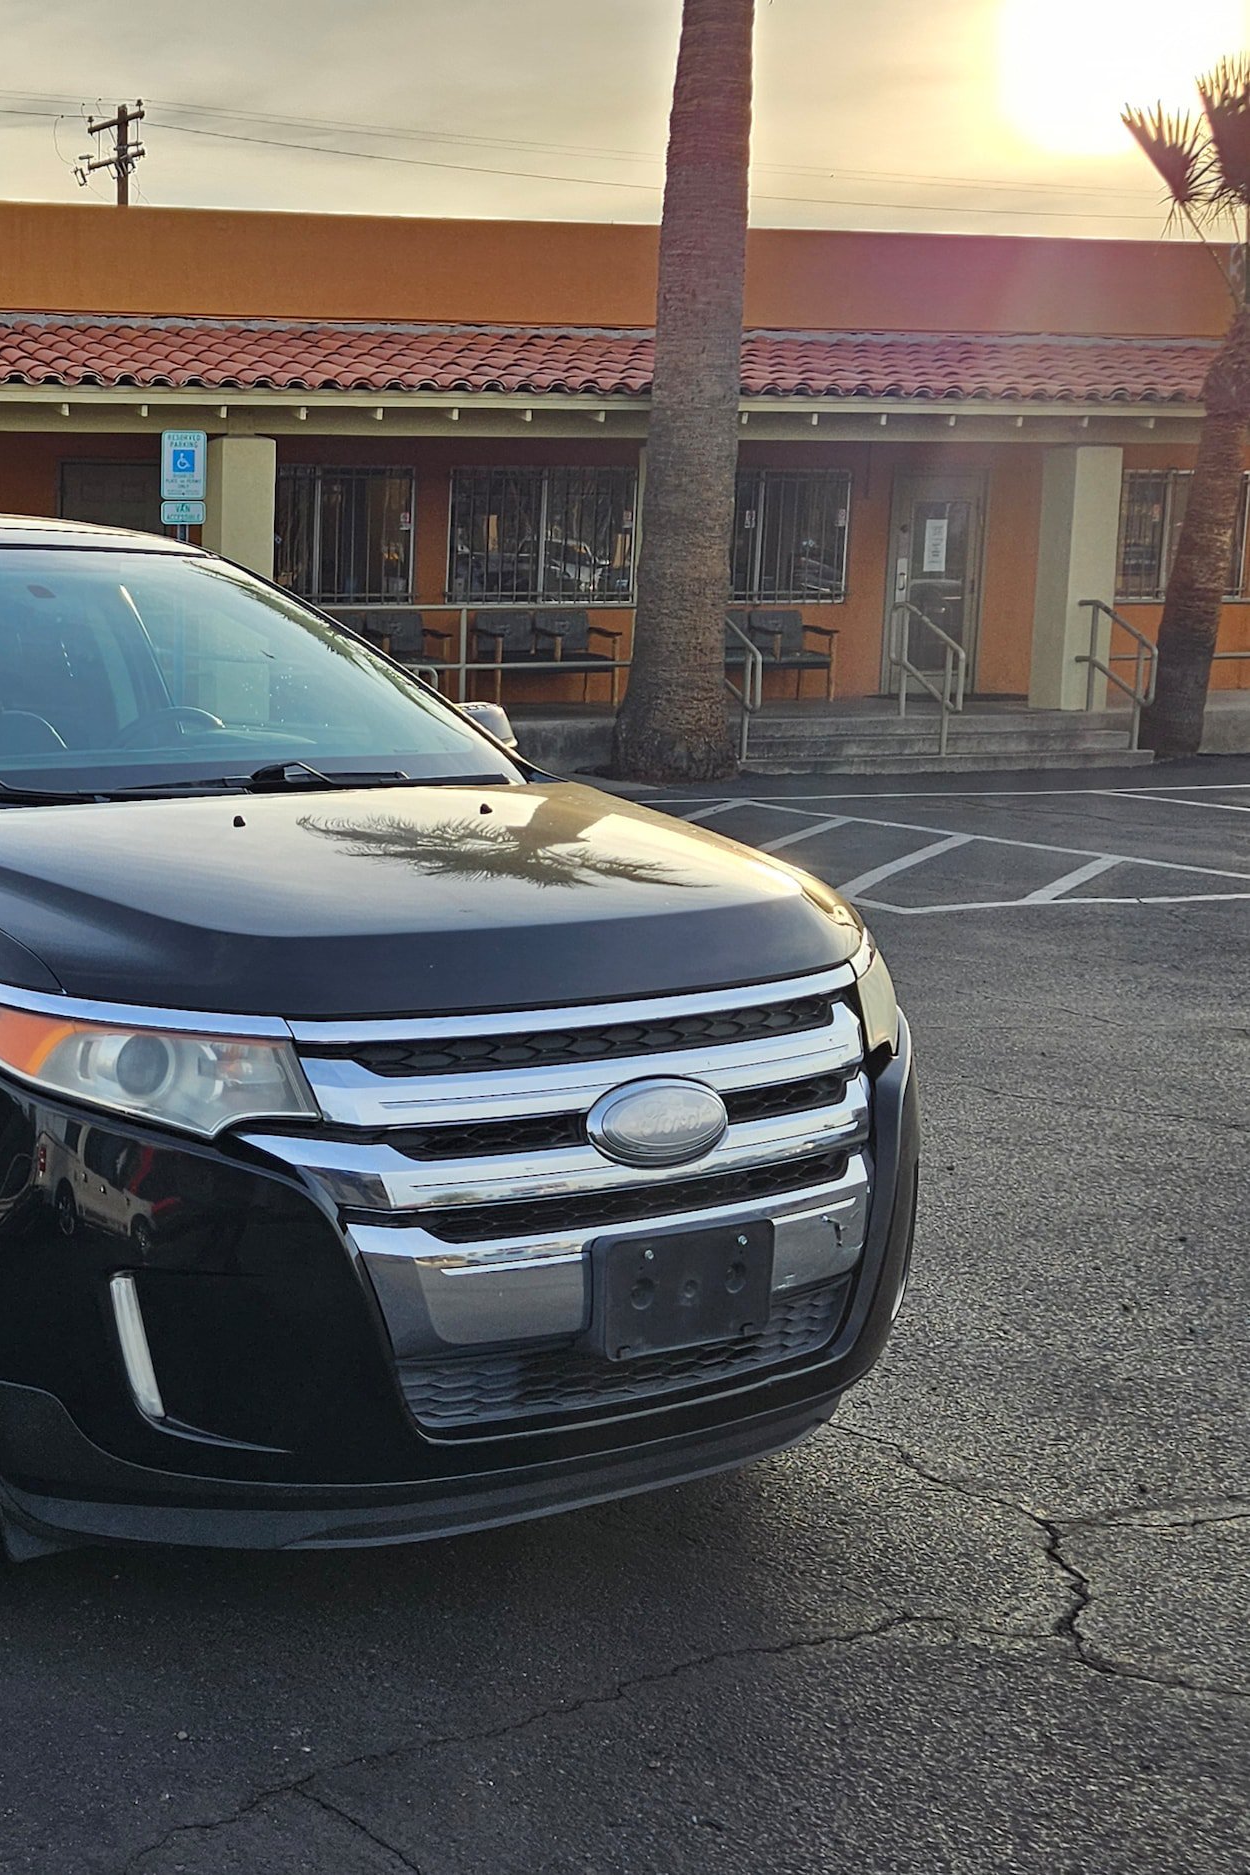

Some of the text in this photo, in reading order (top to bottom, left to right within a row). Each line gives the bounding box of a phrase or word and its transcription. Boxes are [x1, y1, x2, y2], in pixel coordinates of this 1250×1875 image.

[170, 440, 198, 448] PARKING
[176, 503, 190, 512] VAN
[638, 1098, 713, 1137] Ford
